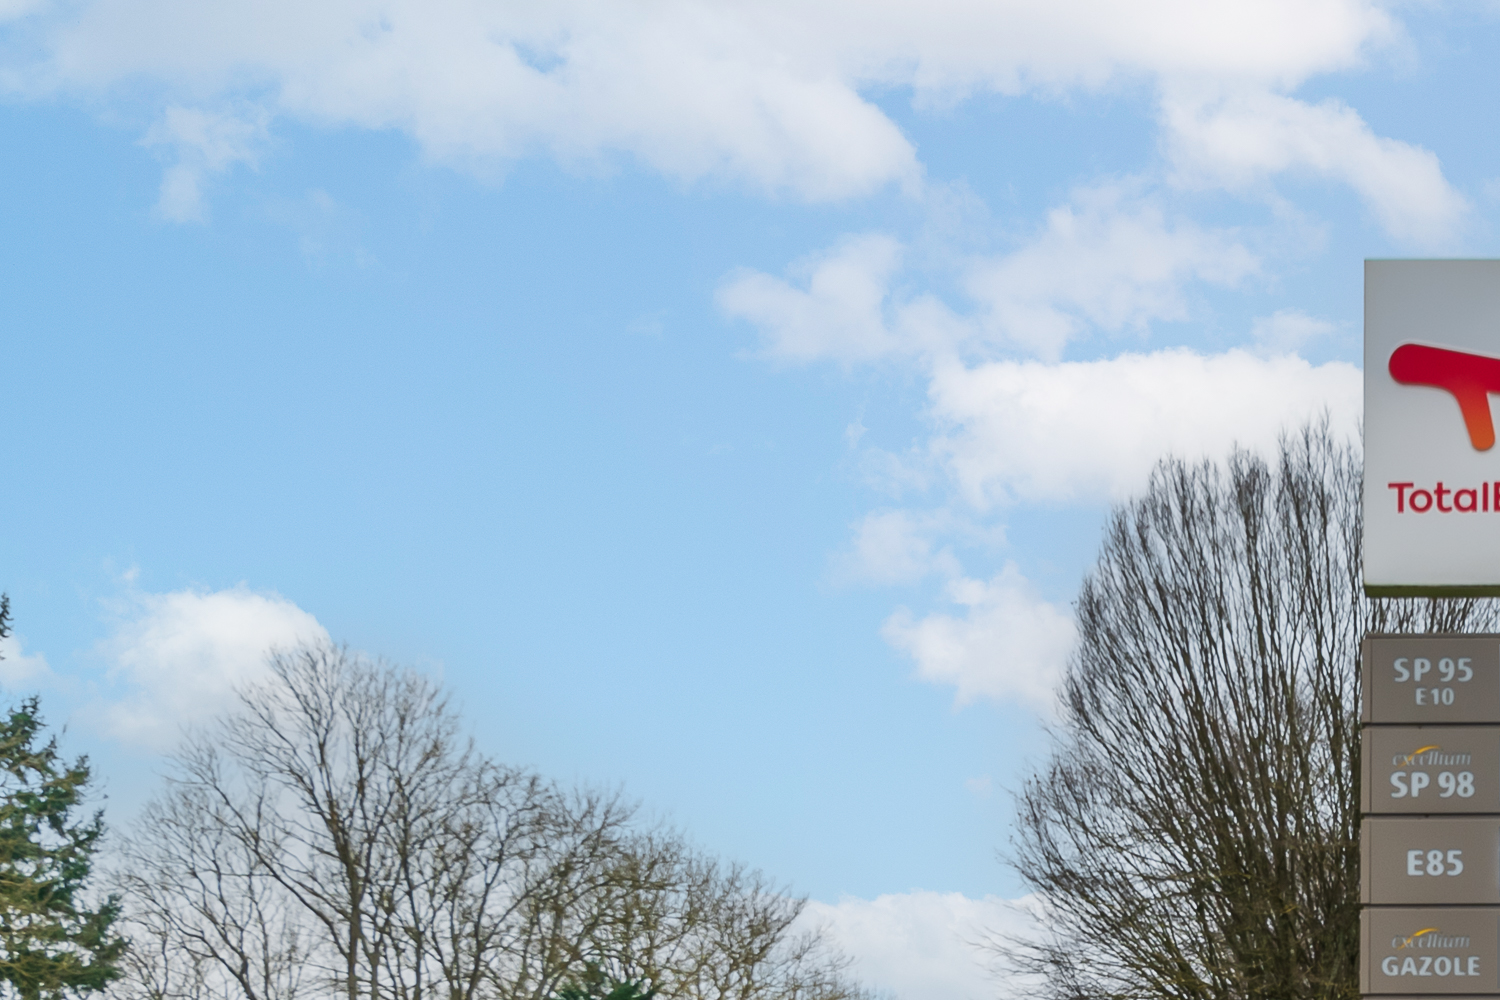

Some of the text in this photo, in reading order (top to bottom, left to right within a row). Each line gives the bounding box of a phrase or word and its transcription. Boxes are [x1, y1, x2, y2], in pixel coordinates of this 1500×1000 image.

[1393, 658, 1474, 683] SP 95
[1390, 771, 1475, 798] SP 98
[1407, 850, 1464, 877] E85
[1381, 956, 1481, 977] GAZOLE
